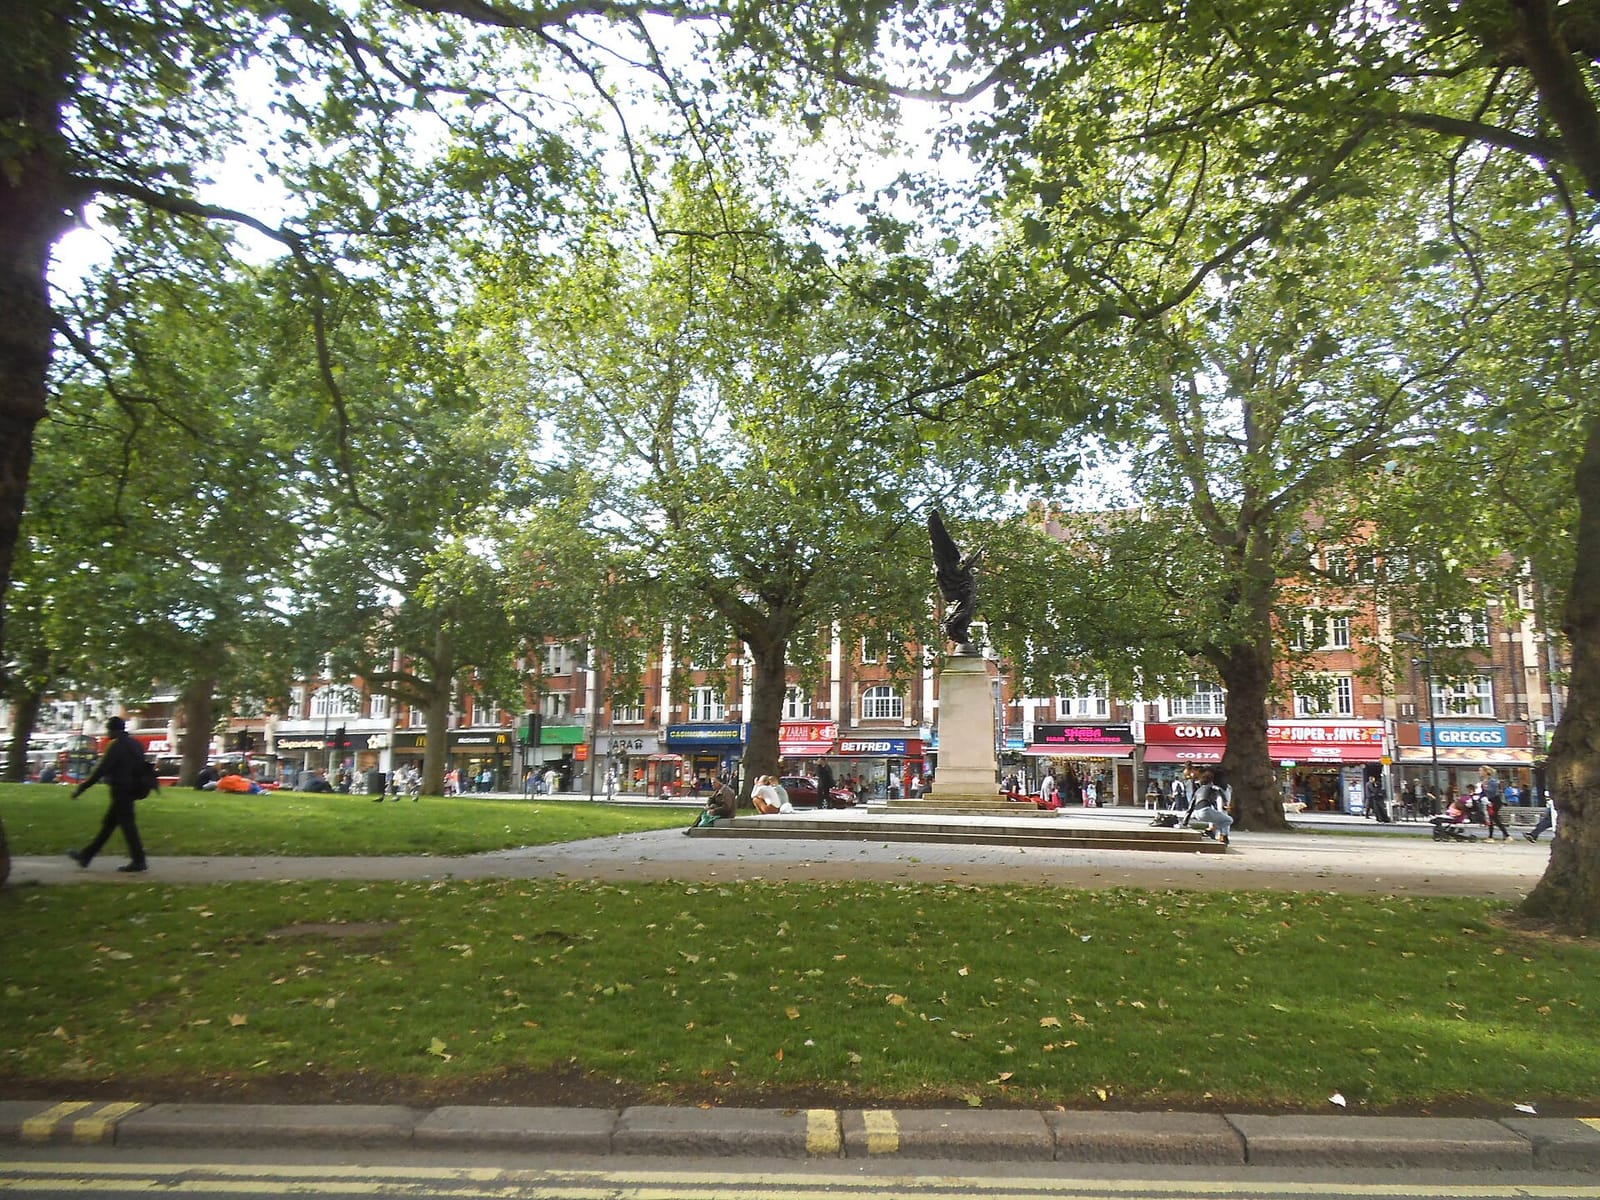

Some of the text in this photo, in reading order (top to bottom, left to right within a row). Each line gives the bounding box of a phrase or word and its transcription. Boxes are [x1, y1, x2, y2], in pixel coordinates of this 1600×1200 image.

[1175, 726, 1222, 738] COSTA
[1291, 727, 1325, 741] SUPER
[1334, 727, 1361, 741] SAVE
[1438, 730, 1502, 743] GREGGS
[840, 741, 891, 753] BETFRED
[1175, 752, 1220, 760] COSTA
